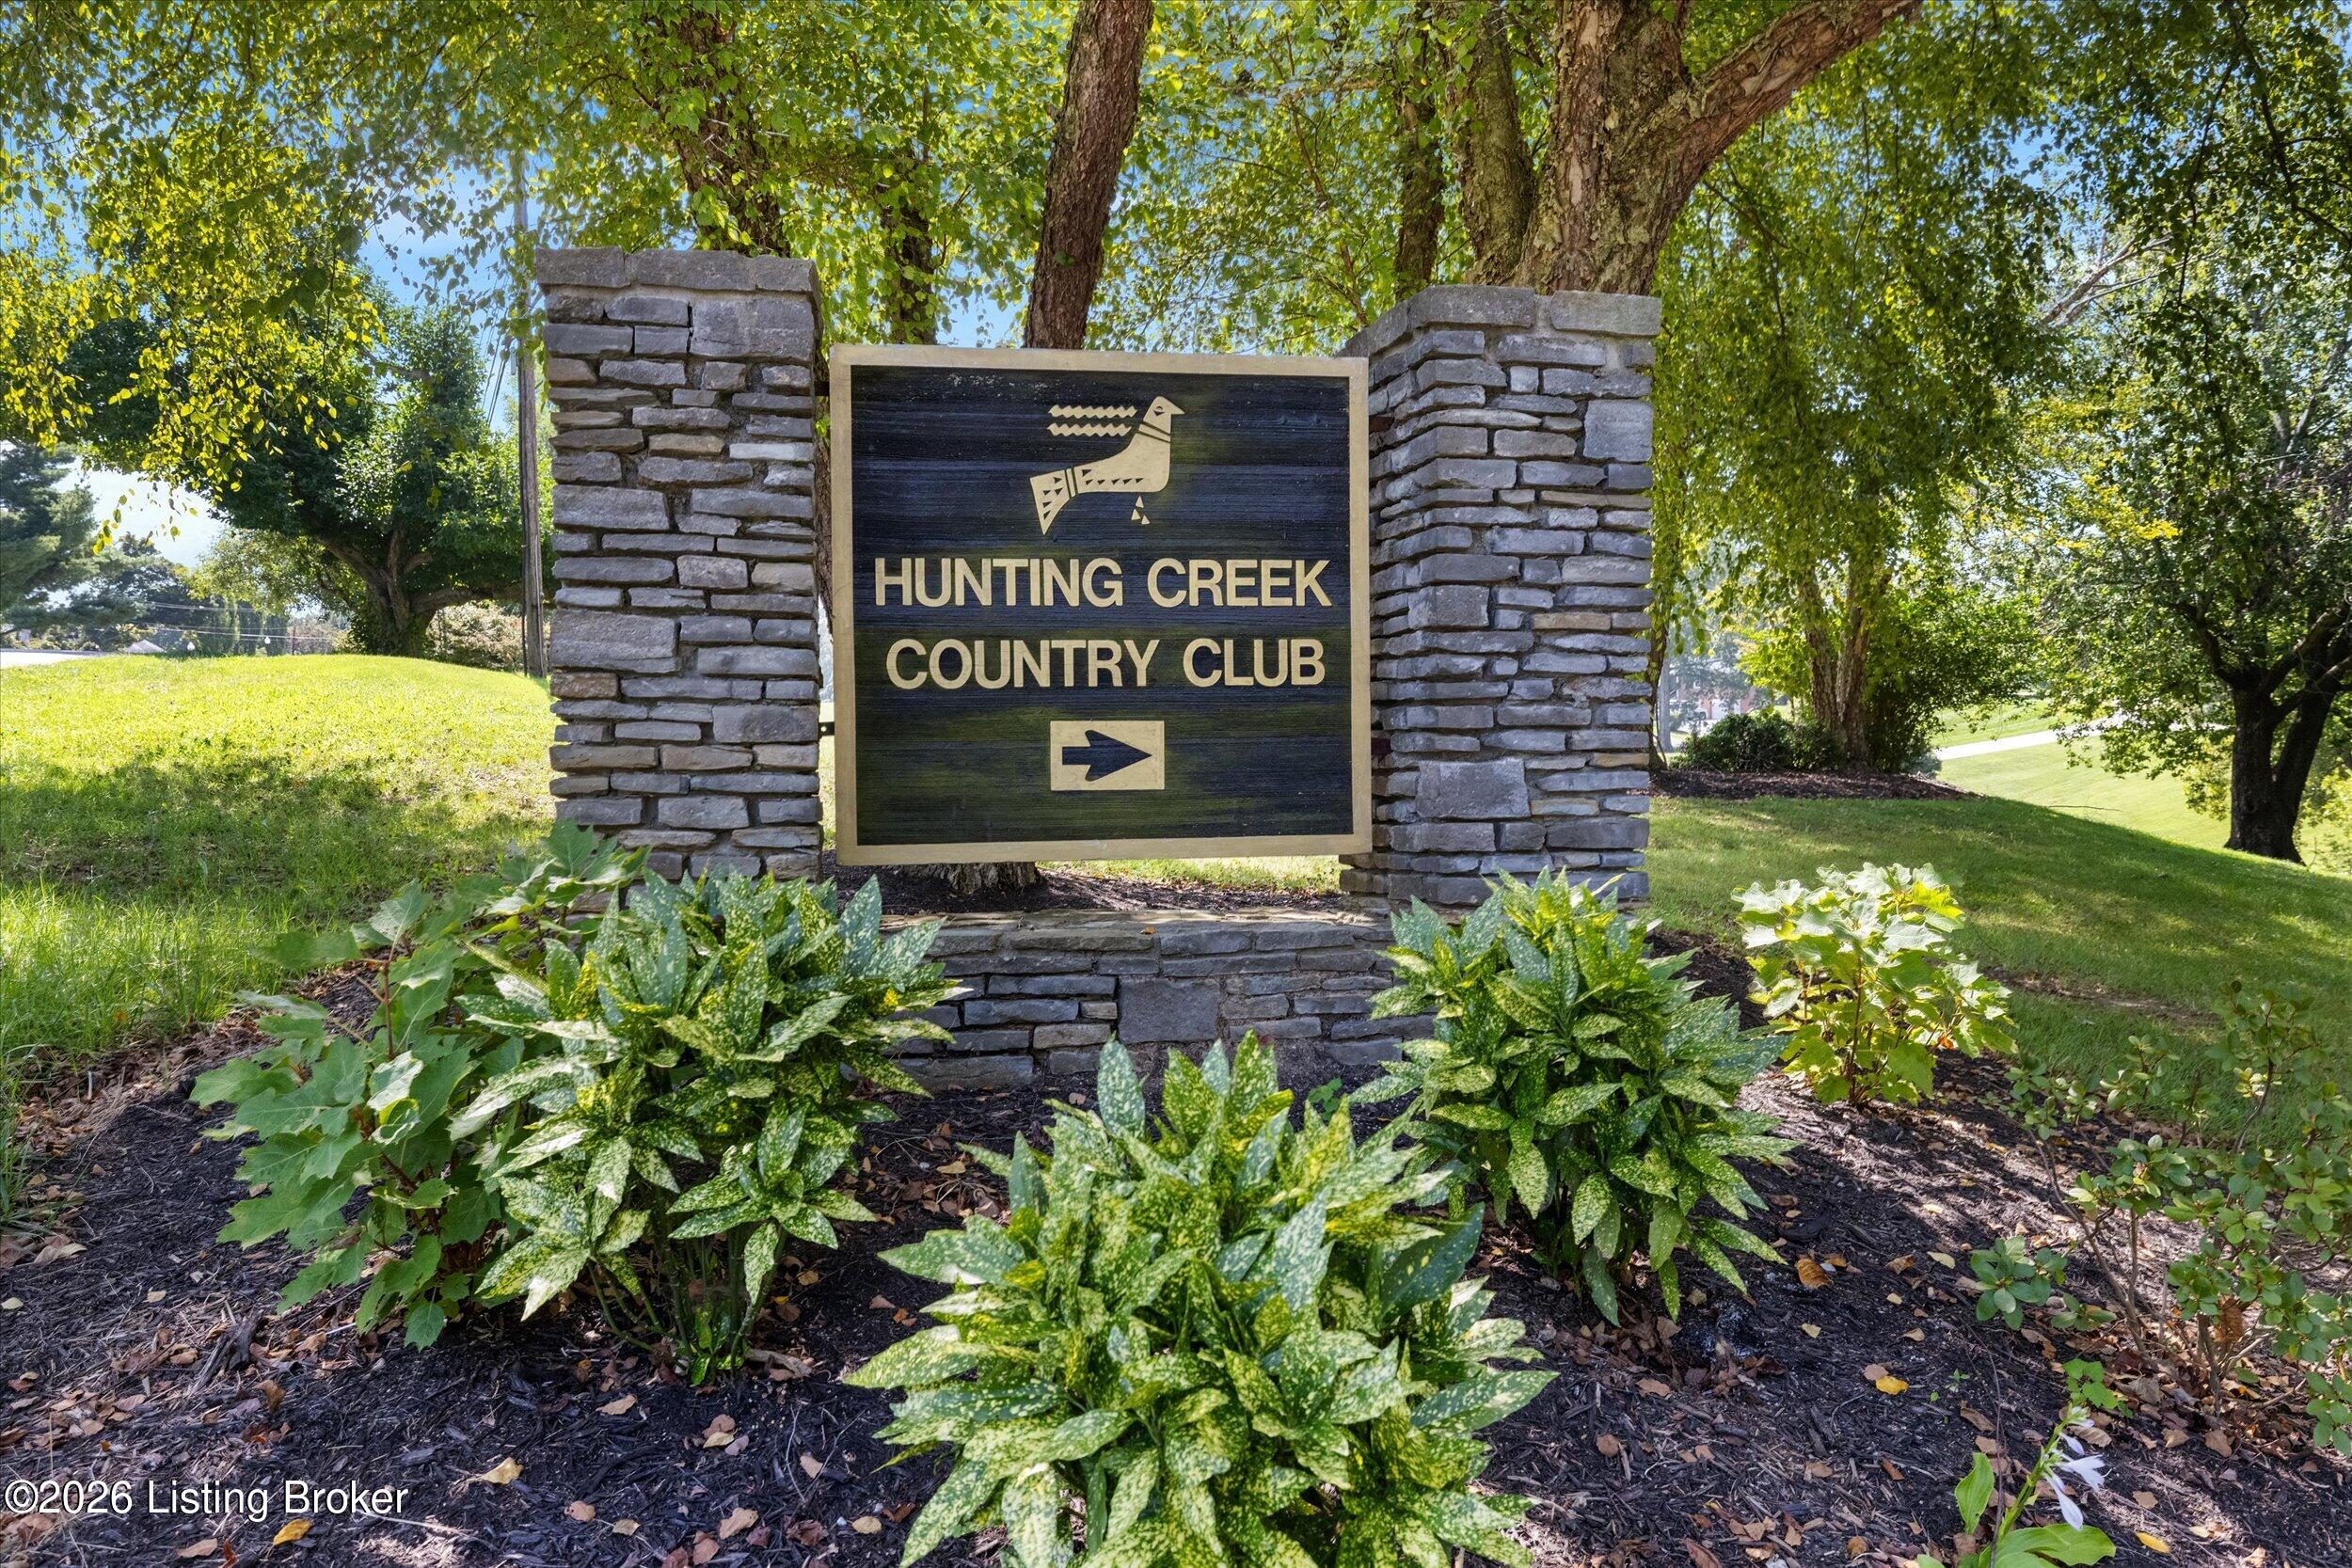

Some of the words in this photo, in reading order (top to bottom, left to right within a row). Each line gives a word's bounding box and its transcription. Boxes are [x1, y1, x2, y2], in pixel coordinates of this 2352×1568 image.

[874, 557, 1124, 608] HUNTING
[1146, 558, 1333, 608] CREEK
[885, 639, 1160, 690] COUNTRY
[1182, 638, 1327, 689] CLUB
